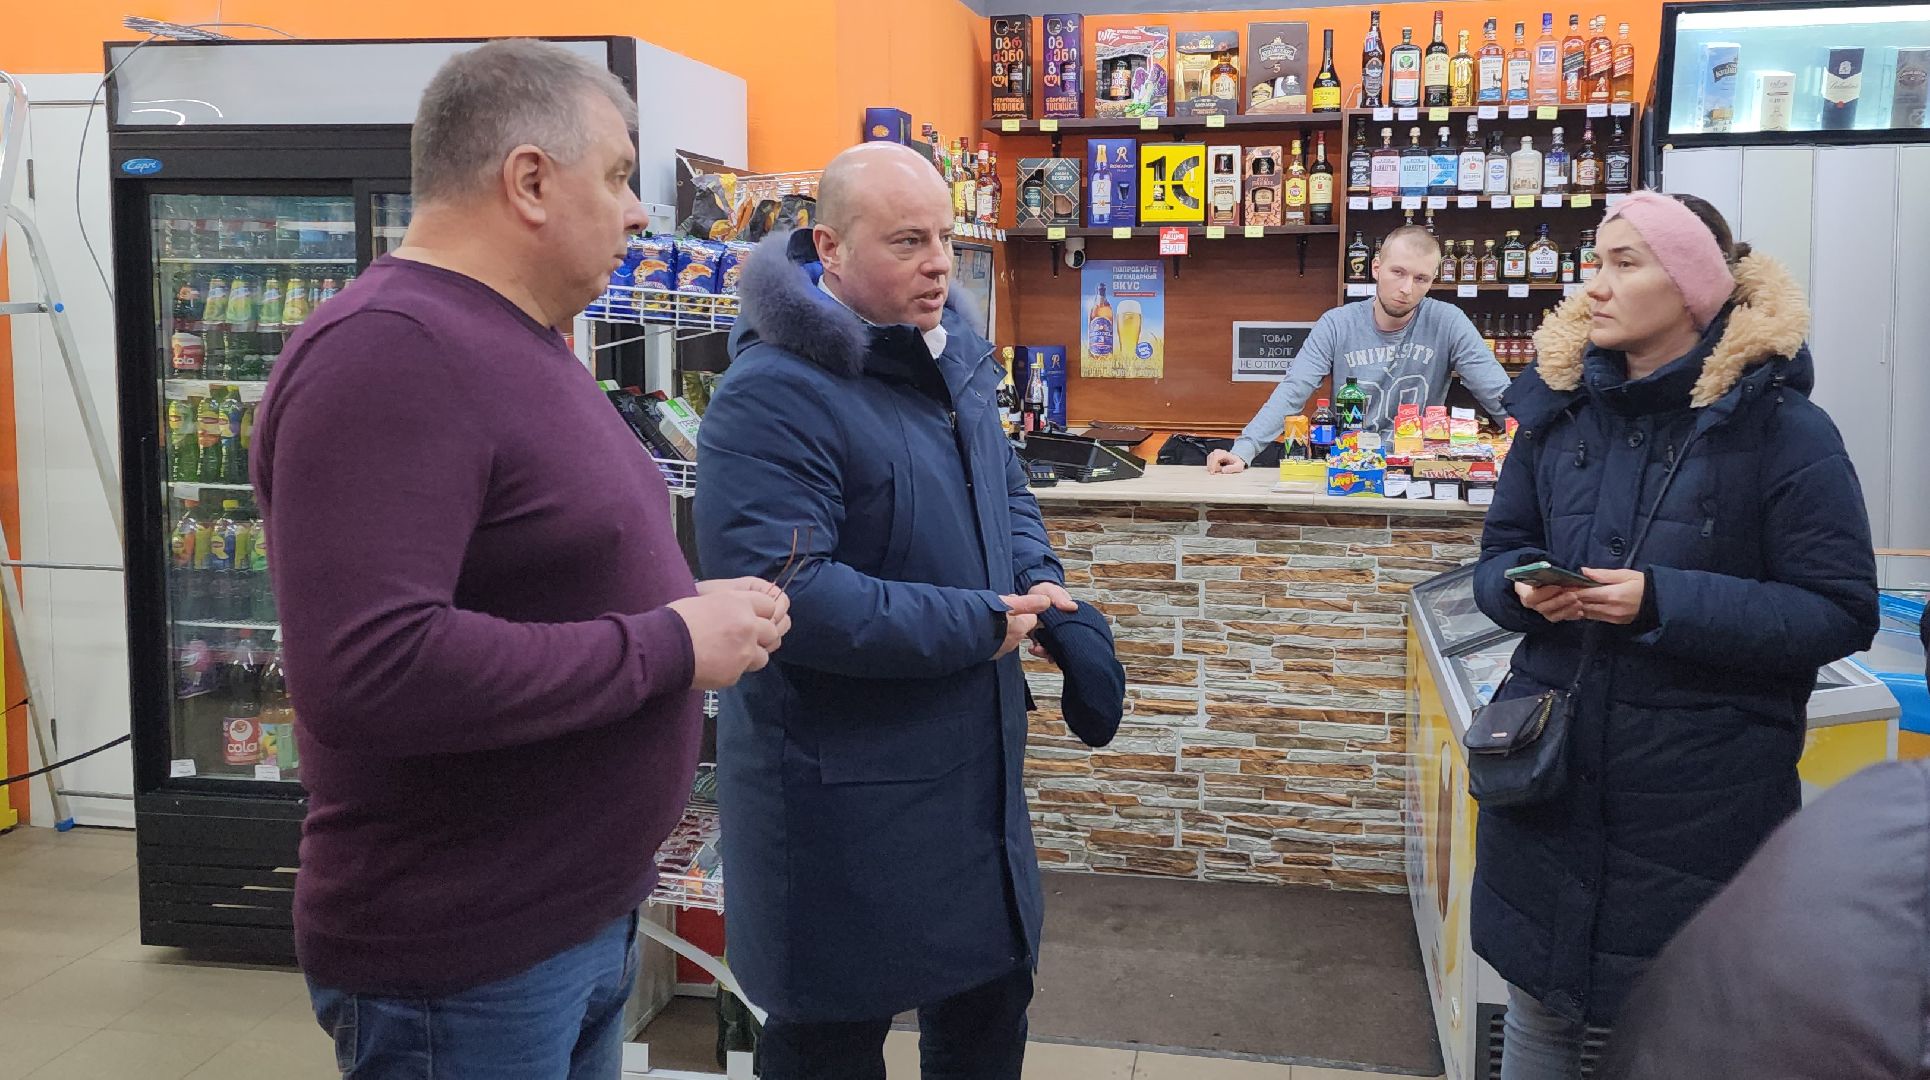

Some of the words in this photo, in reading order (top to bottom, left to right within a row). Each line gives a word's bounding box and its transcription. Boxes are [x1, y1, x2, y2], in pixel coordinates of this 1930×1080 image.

[125, 158, 157, 174] Capri
[1113, 265, 1157, 273] ПОПРОБУЙТЕ
[1113, 281, 1140, 290] ВКУС
[1262, 334, 1293, 343] ТОВАР
[1259, 347, 1265, 355] В
[1267, 347, 1294, 357] ДОЛГ
[1240, 360, 1252, 369] НЕ
[1254, 360, 1293, 369] ОТПУСК
[227, 740, 258, 754] cola
